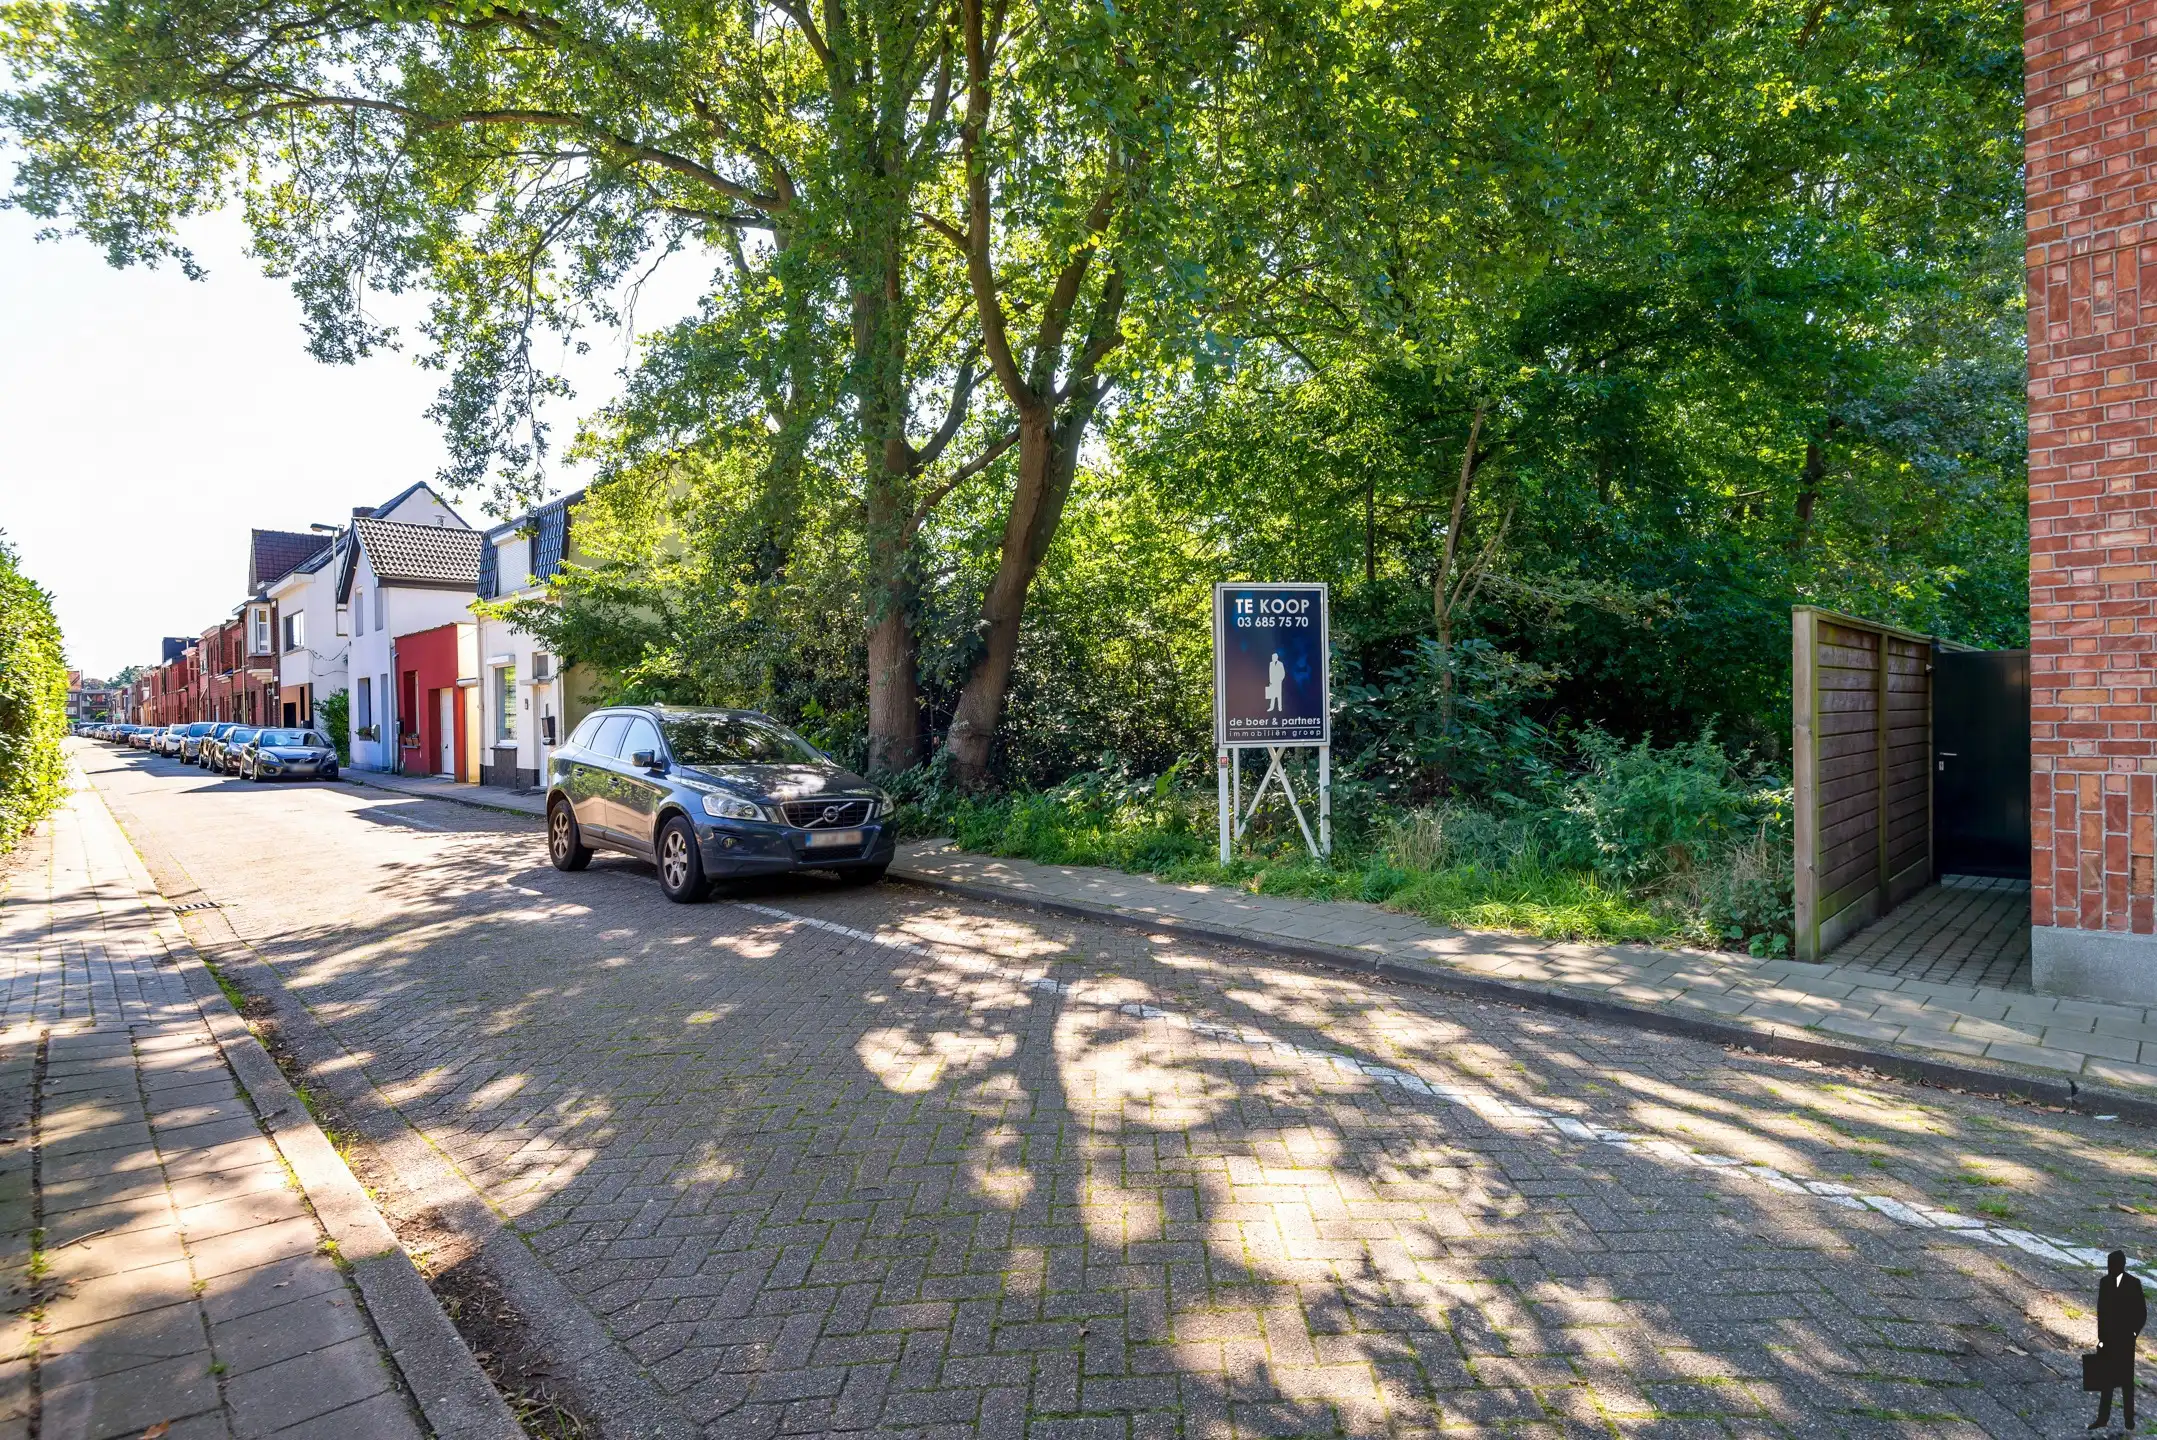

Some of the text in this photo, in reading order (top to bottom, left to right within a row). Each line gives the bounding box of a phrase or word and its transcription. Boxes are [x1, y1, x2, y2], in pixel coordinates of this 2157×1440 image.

[1235, 599, 1310, 613] TE KOOP
[1238, 617, 1308, 627] 03 685 75 70
[1229, 717, 1242, 726] de
[1246, 717, 1268, 726] boer
[1282, 716, 1321, 726] partners
[1292, 729, 1321, 737] groep
